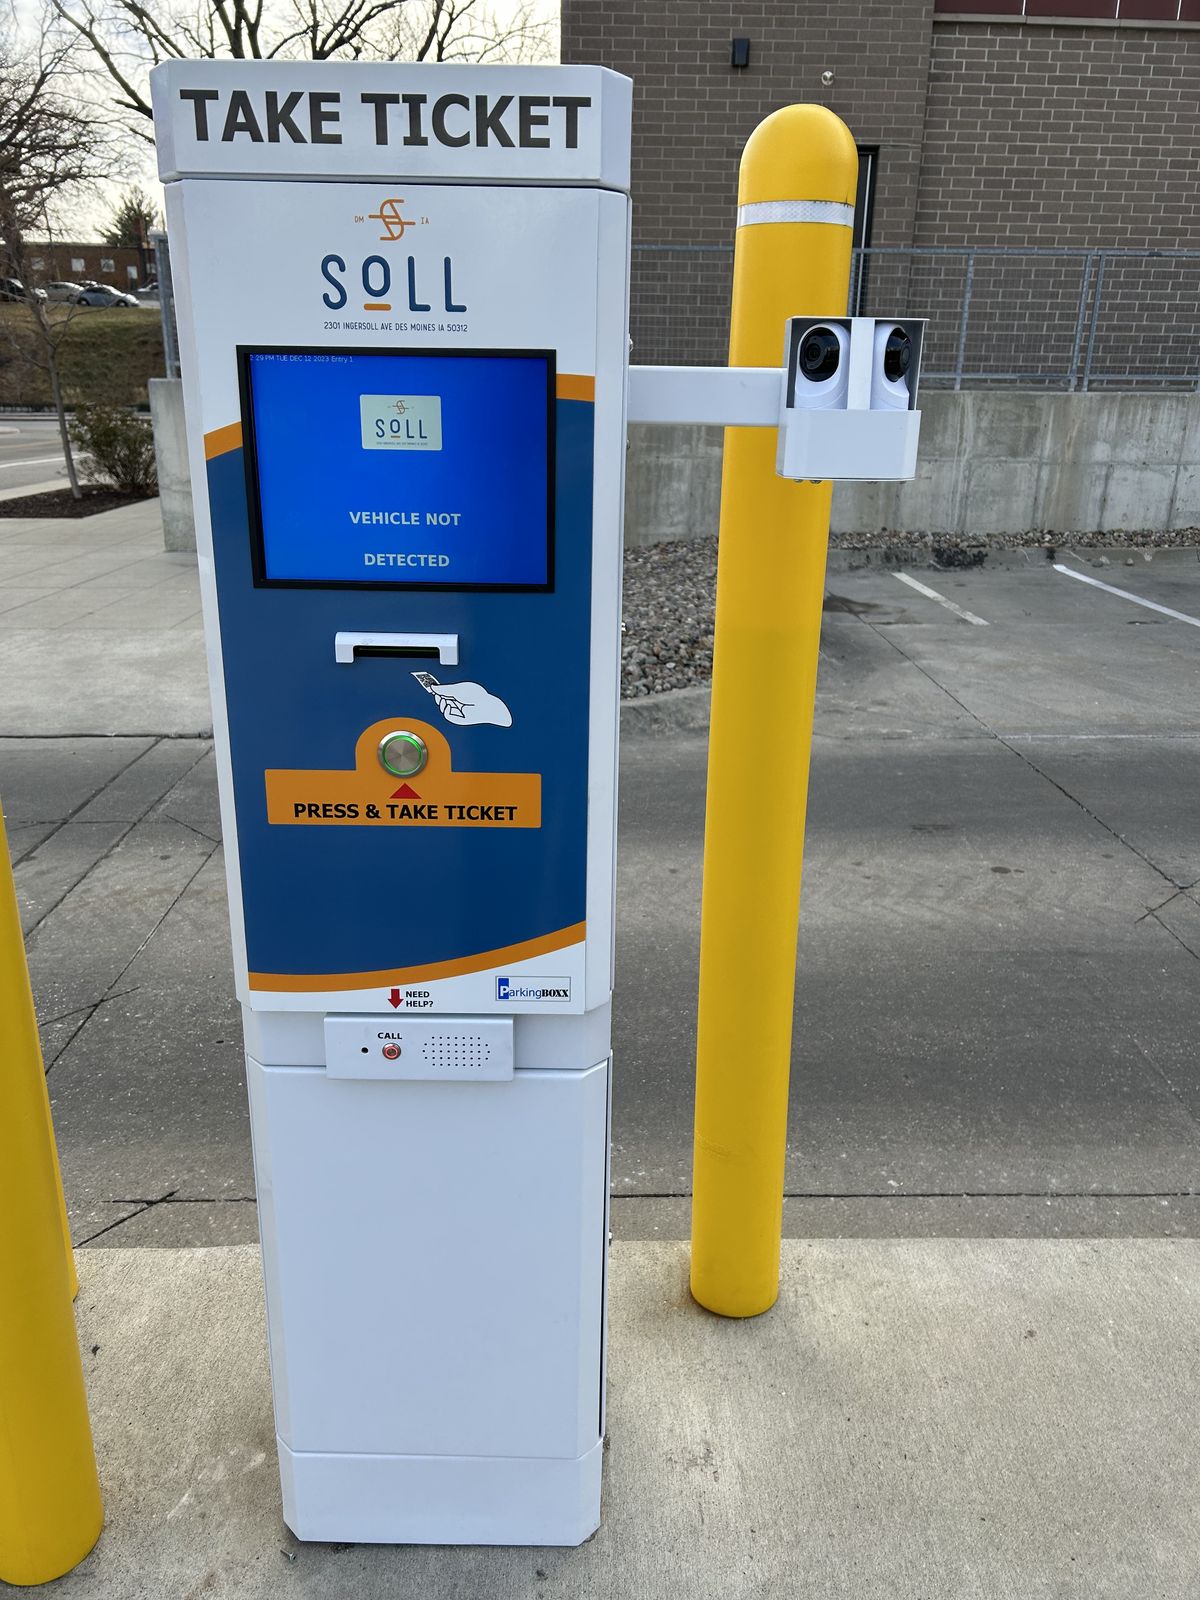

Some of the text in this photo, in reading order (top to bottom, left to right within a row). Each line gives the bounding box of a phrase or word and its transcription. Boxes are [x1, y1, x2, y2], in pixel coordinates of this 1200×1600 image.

[179, 88, 592, 149] TAKE TICKET
[321, 254, 467, 312] SOLL
[323, 321, 468, 332] 2301 INGERSOLL AVE DES MOINES IA 50312
[331, 356, 348, 364] Entry
[375, 418, 428, 439] SOLL
[349, 511, 461, 526] VEHICLE NOT
[364, 553, 450, 568] DETECTED
[293, 803, 518, 821] PRESS & TAKE TICKET
[405, 990, 430, 998] NEED
[499, 985, 569, 999] ParkingBOXX
[405, 1000, 434, 1008] HELP?
[377, 1032, 403, 1040] CALL
